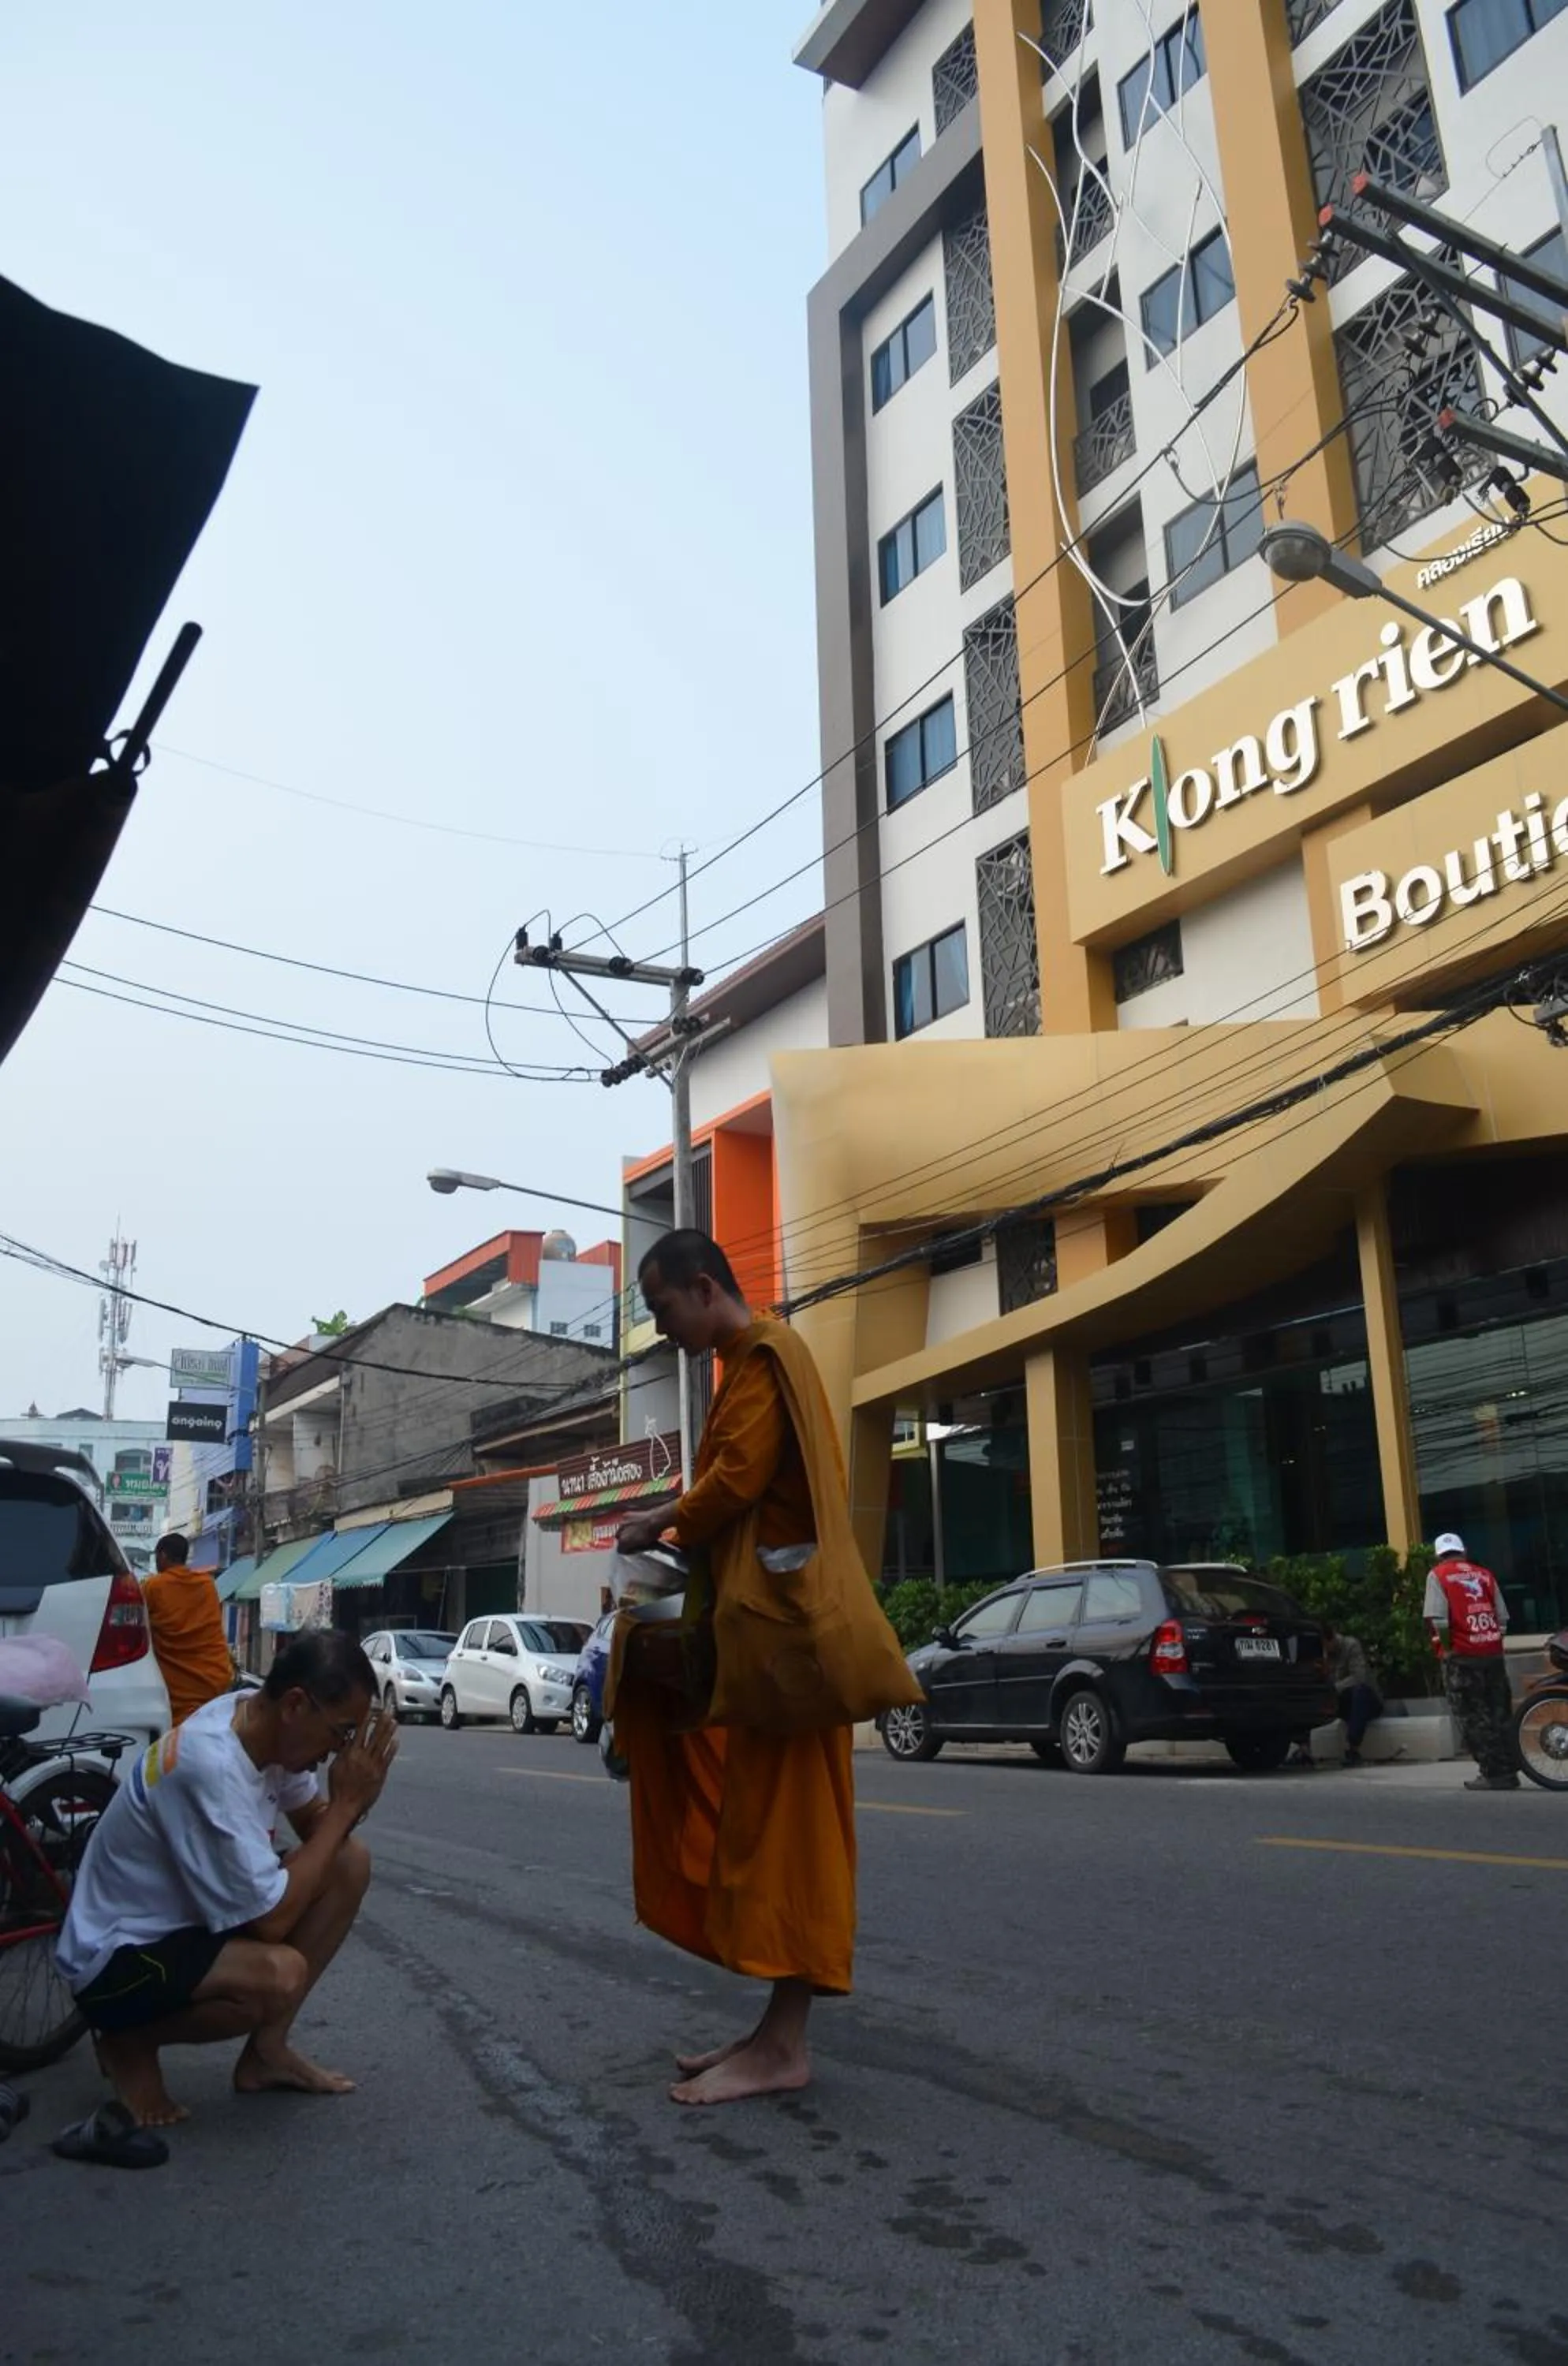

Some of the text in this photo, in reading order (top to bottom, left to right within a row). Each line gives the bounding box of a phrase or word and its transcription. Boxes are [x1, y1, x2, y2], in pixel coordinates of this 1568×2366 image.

[1095, 576, 1540, 876] Klong rien
[171, 1416, 222, 1430] ongoing
